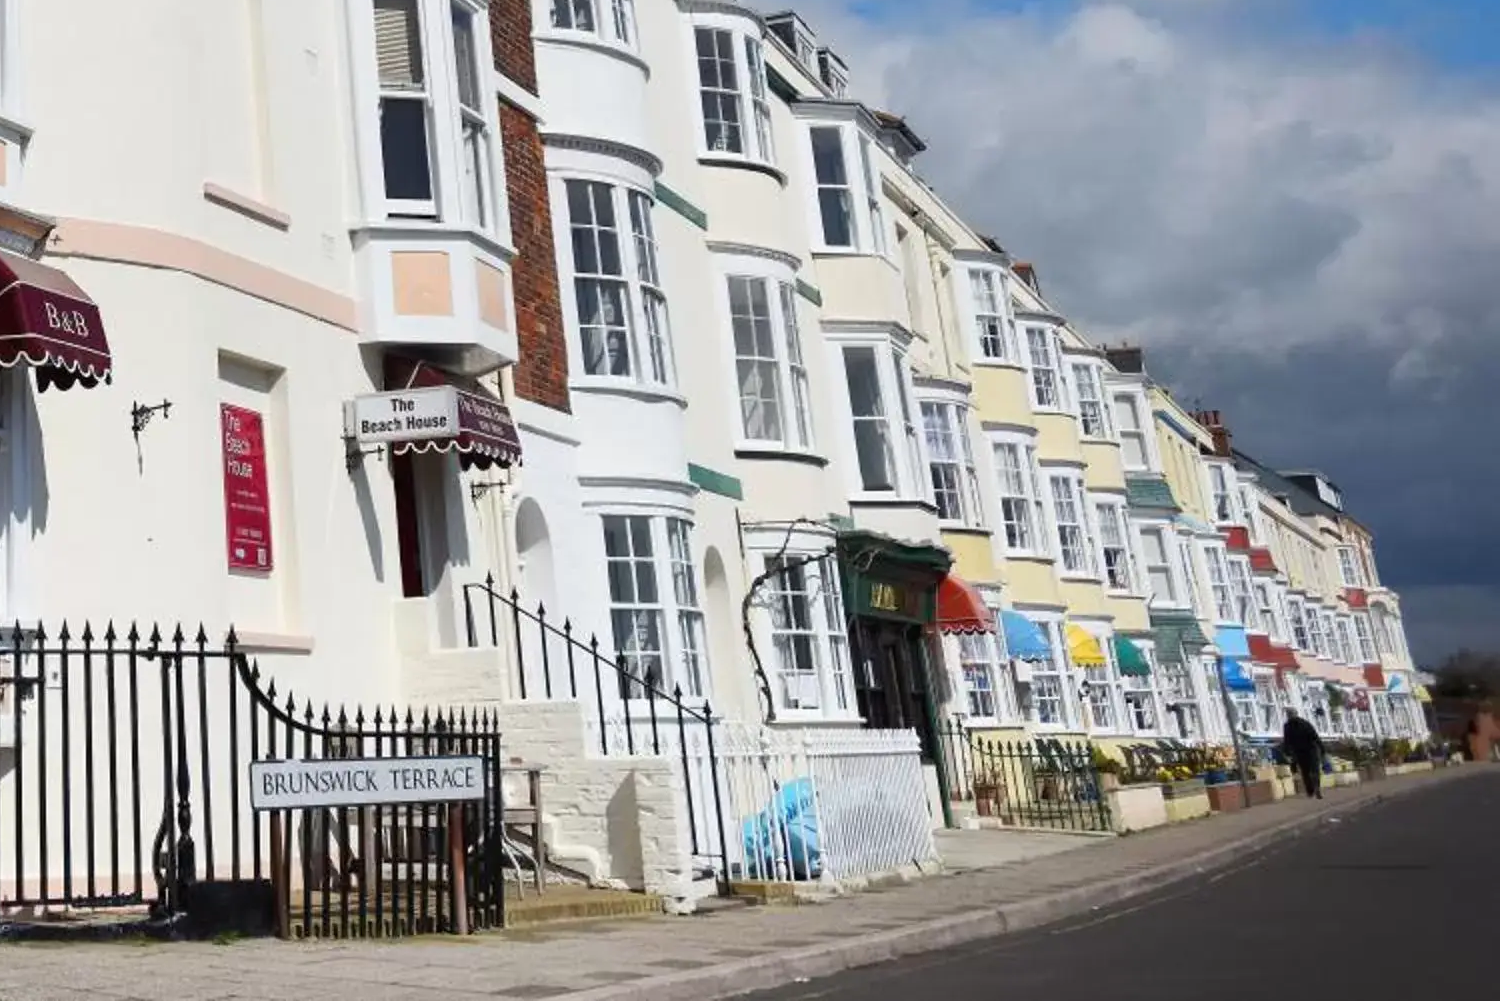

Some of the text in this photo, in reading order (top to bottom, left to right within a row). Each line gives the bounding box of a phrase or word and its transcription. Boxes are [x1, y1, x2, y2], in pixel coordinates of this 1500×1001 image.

[44, 302, 89, 337] B&B
[390, 398, 415, 412] The
[361, 415, 447, 434] Beach House
[262, 766, 476, 796] BRUNSWICK TERRACE
